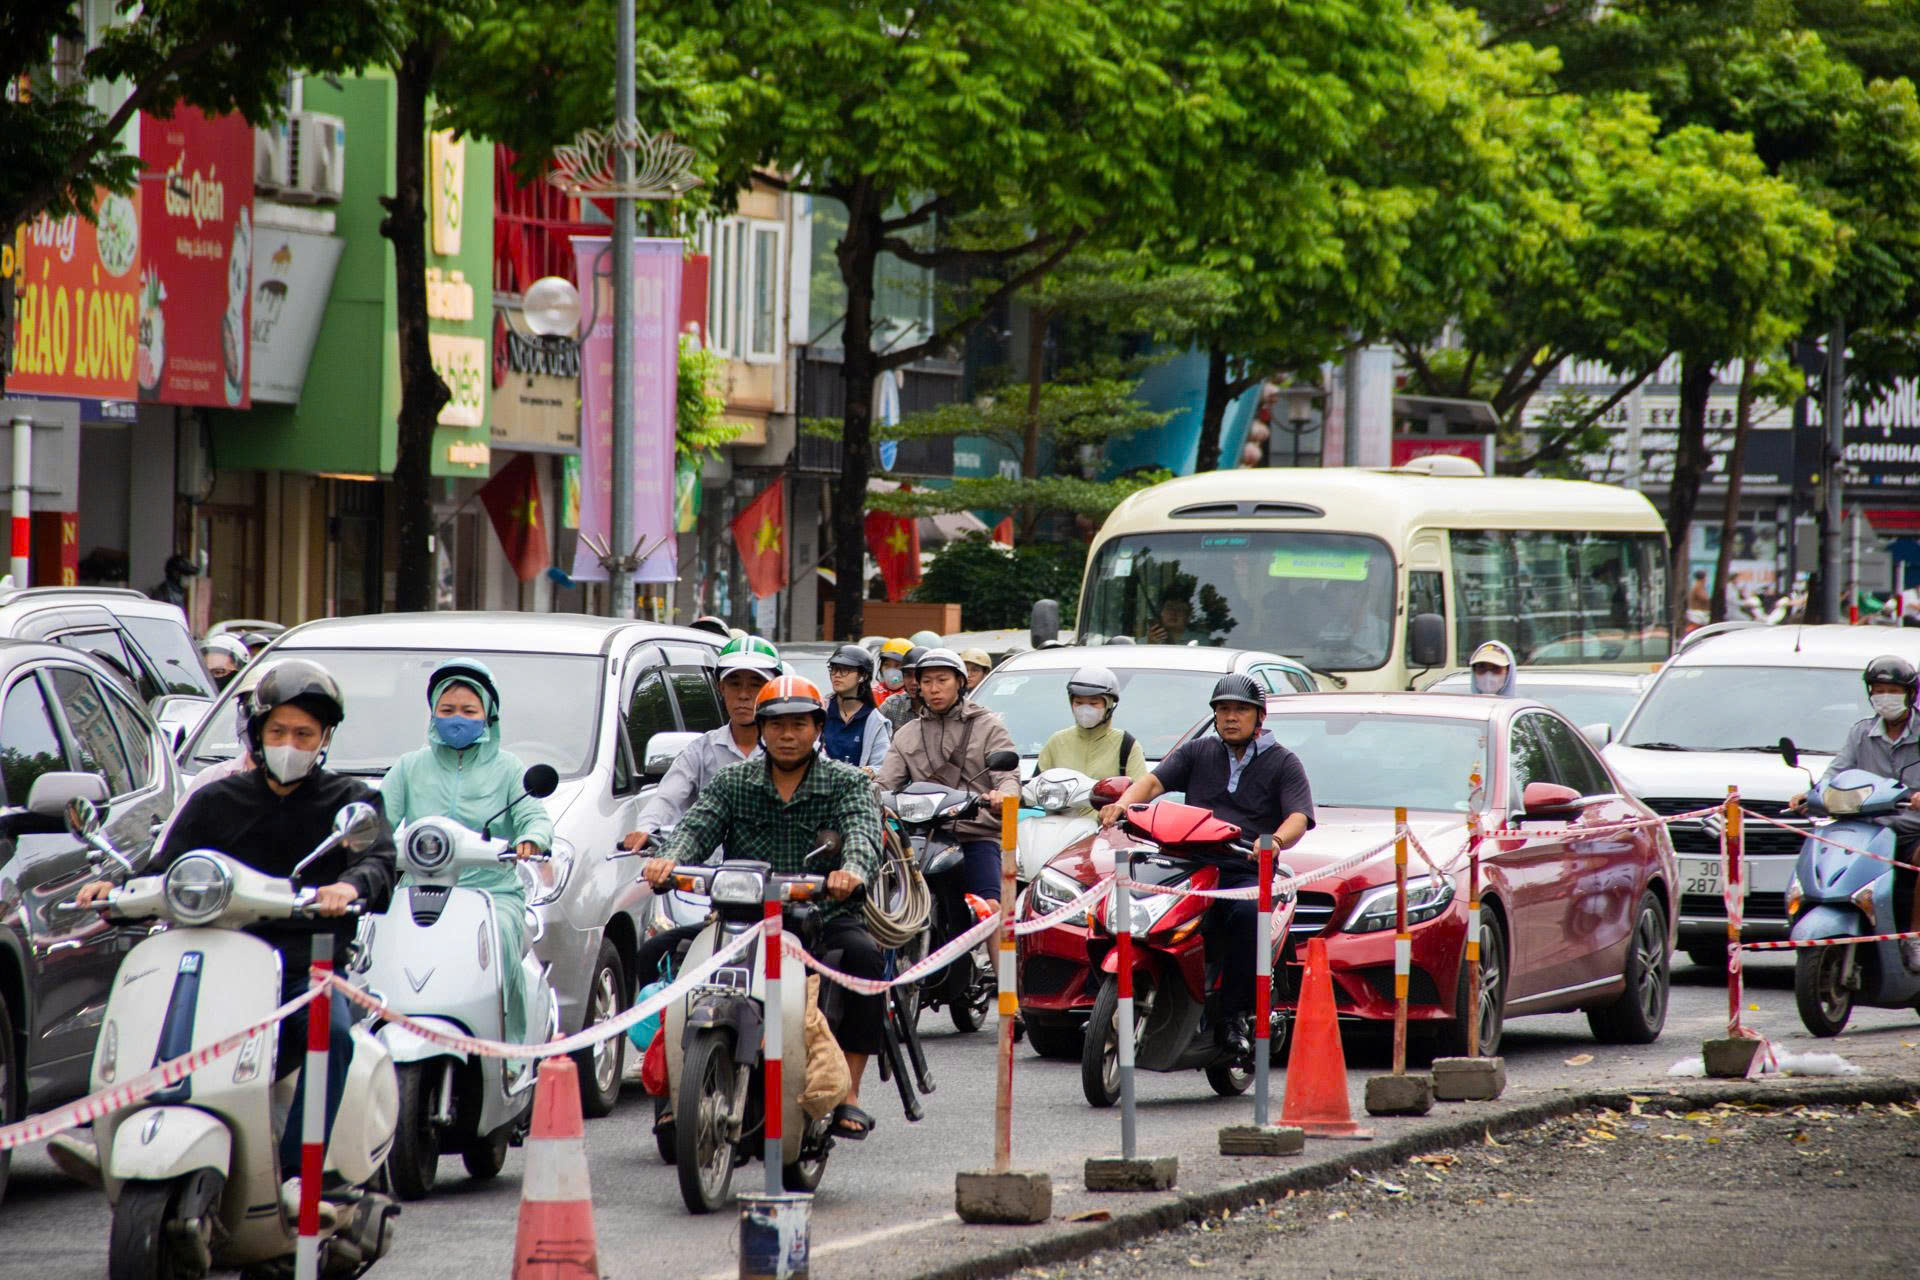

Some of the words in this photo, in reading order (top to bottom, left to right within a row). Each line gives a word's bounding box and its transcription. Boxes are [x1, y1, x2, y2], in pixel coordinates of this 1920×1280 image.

[14, 257, 70, 377] HÁO
[75, 263, 136, 383] LÒNG
[1699, 861, 1719, 877] 30
